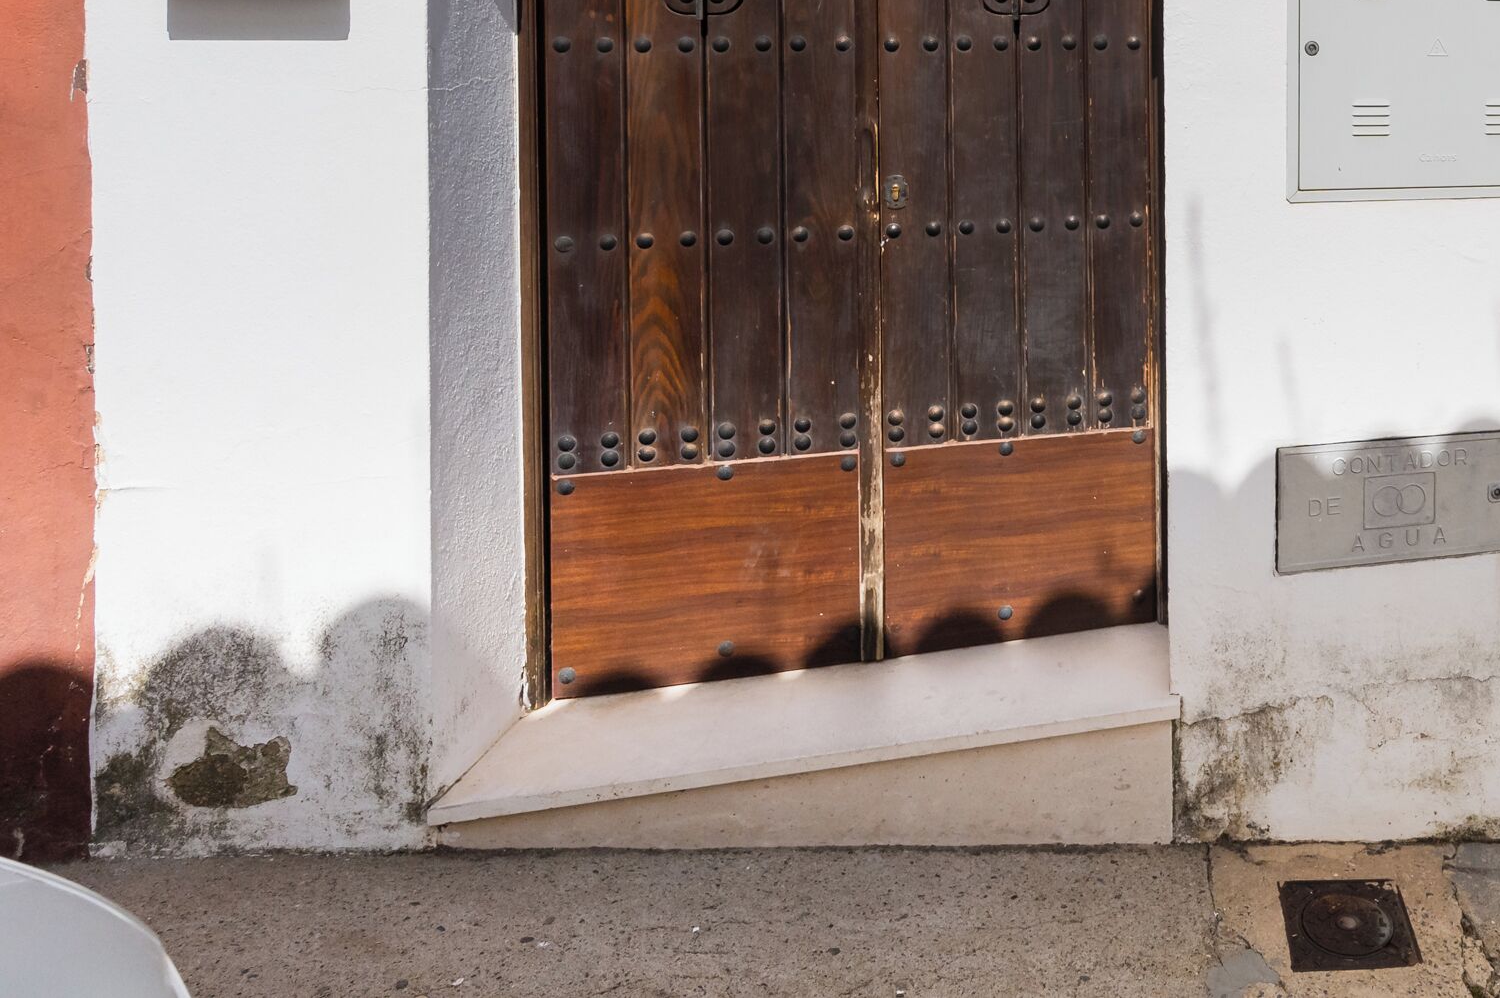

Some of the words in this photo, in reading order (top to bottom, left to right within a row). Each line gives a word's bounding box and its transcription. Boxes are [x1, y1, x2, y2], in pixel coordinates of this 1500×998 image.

[1331, 448, 1469, 477] CONTADOR
[1307, 497, 1342, 518] DE
[1351, 526, 1448, 553] AGUA
